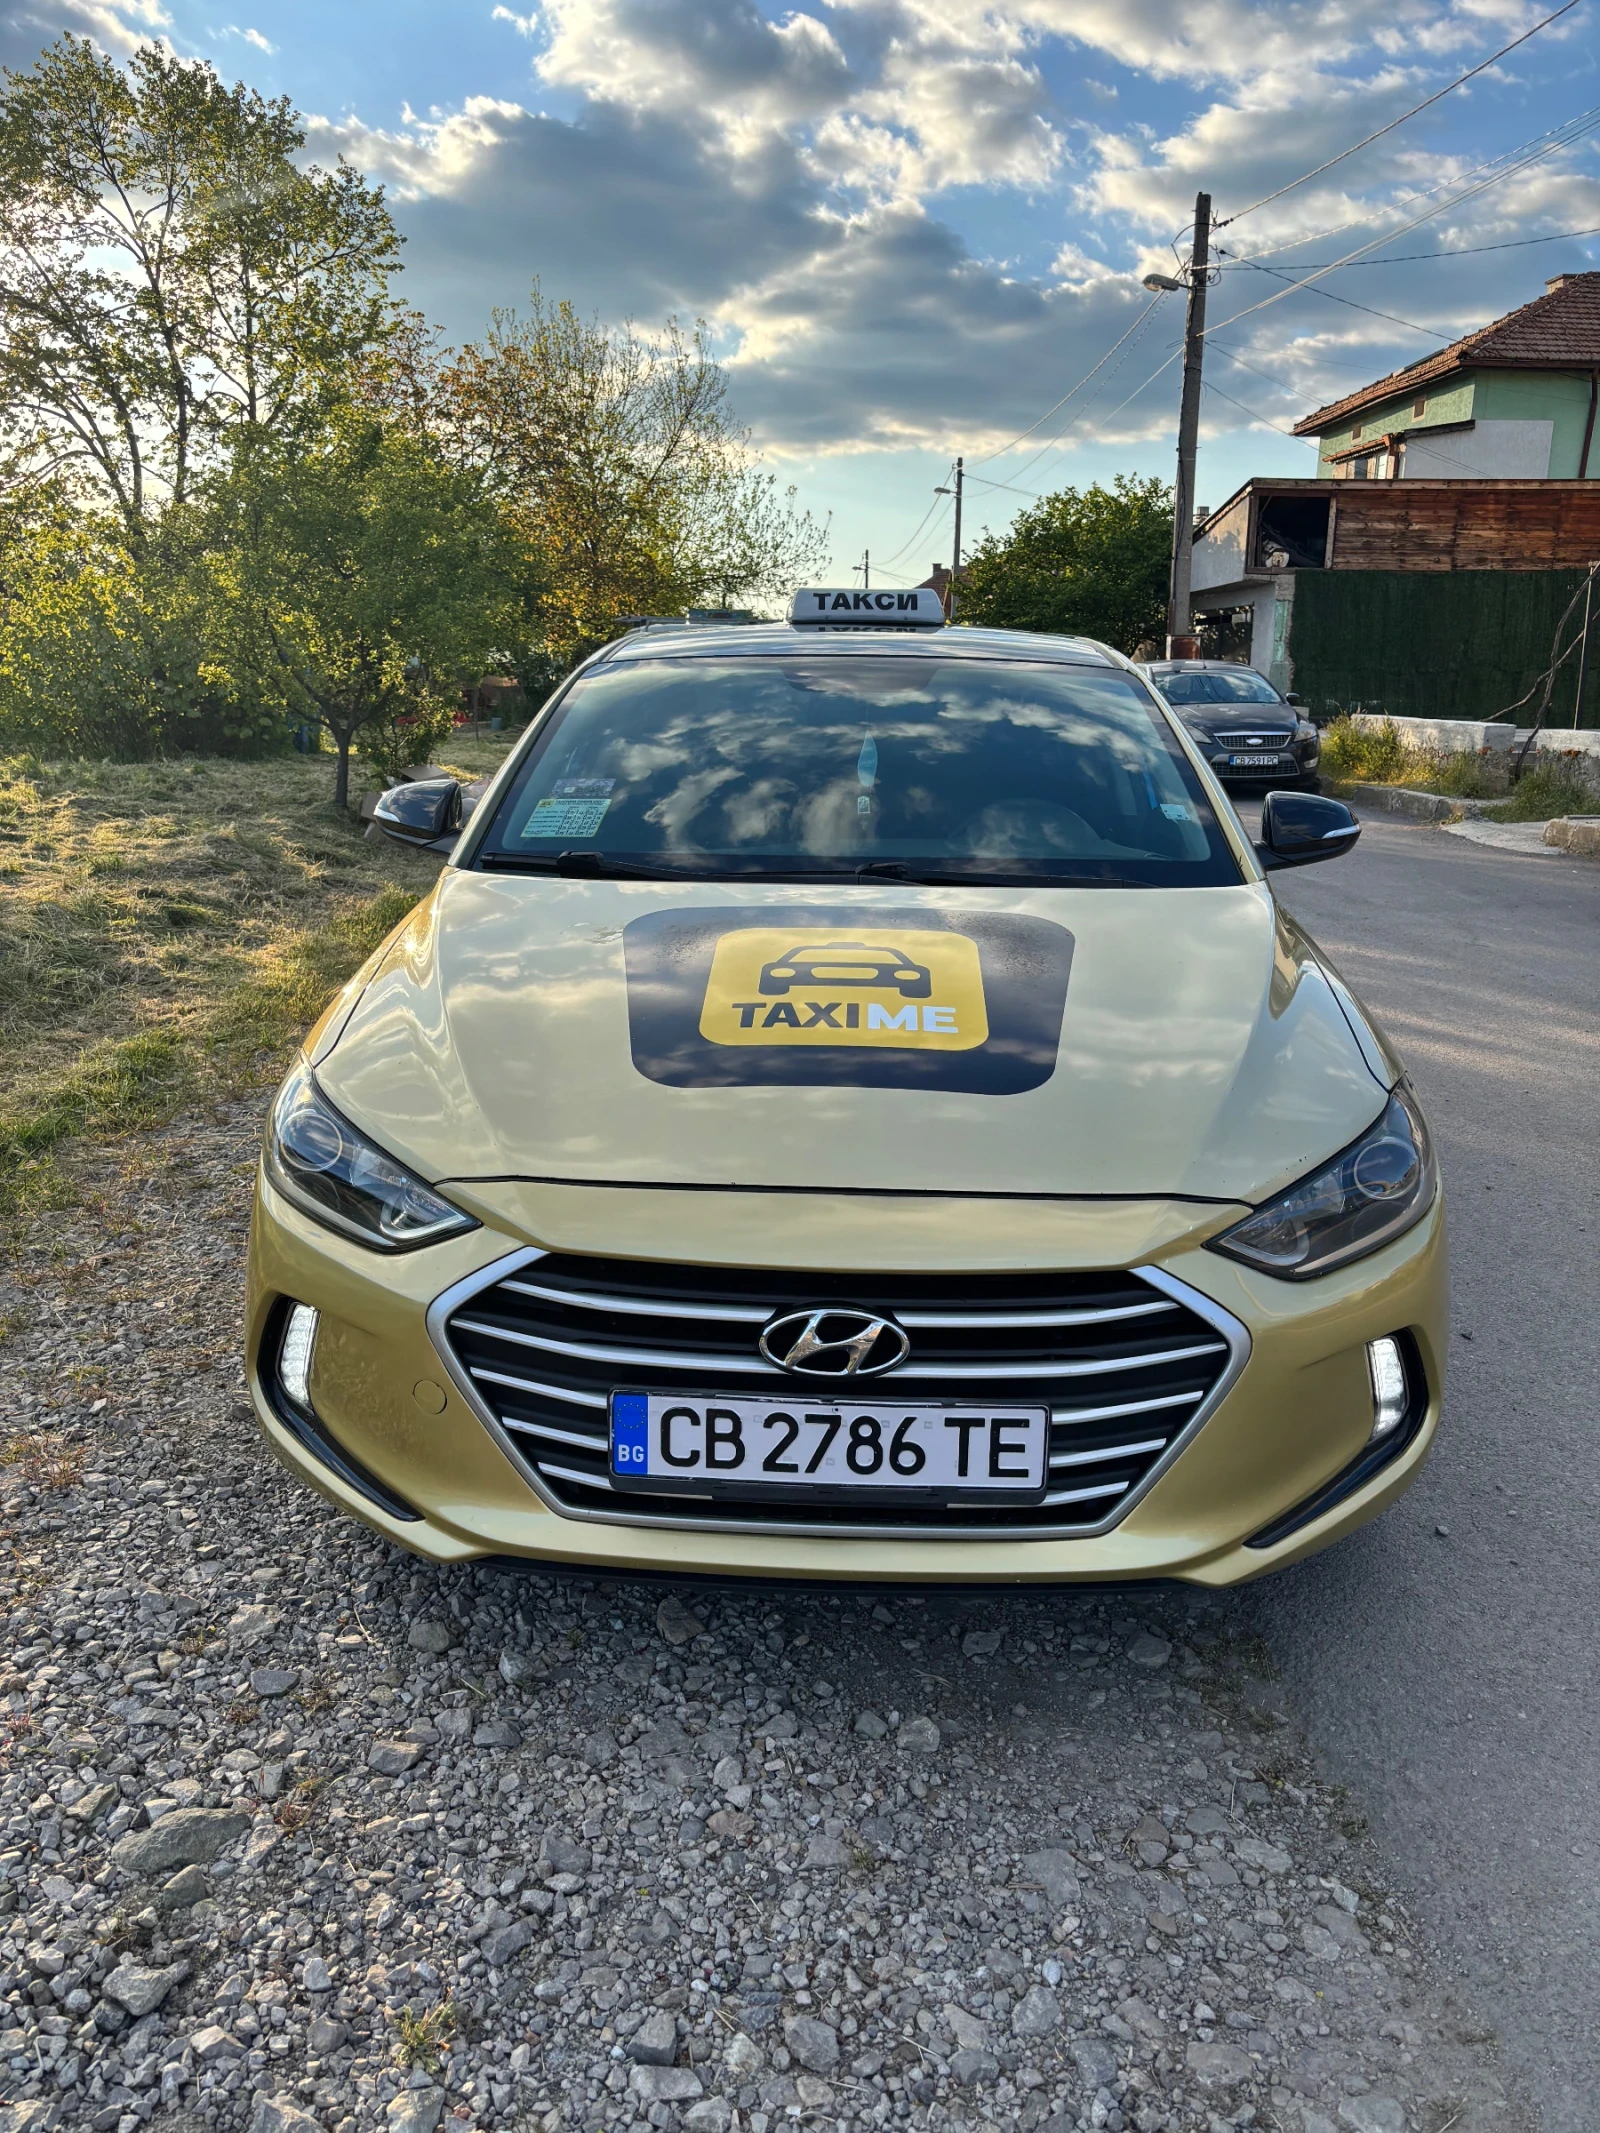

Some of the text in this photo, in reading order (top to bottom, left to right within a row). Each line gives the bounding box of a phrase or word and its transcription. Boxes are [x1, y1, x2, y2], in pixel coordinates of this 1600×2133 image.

[812, 592, 918, 611] ТАКСИ
[659, 1406, 1030, 1479] CB 2786 TE
[618, 1445, 645, 1463] BG
